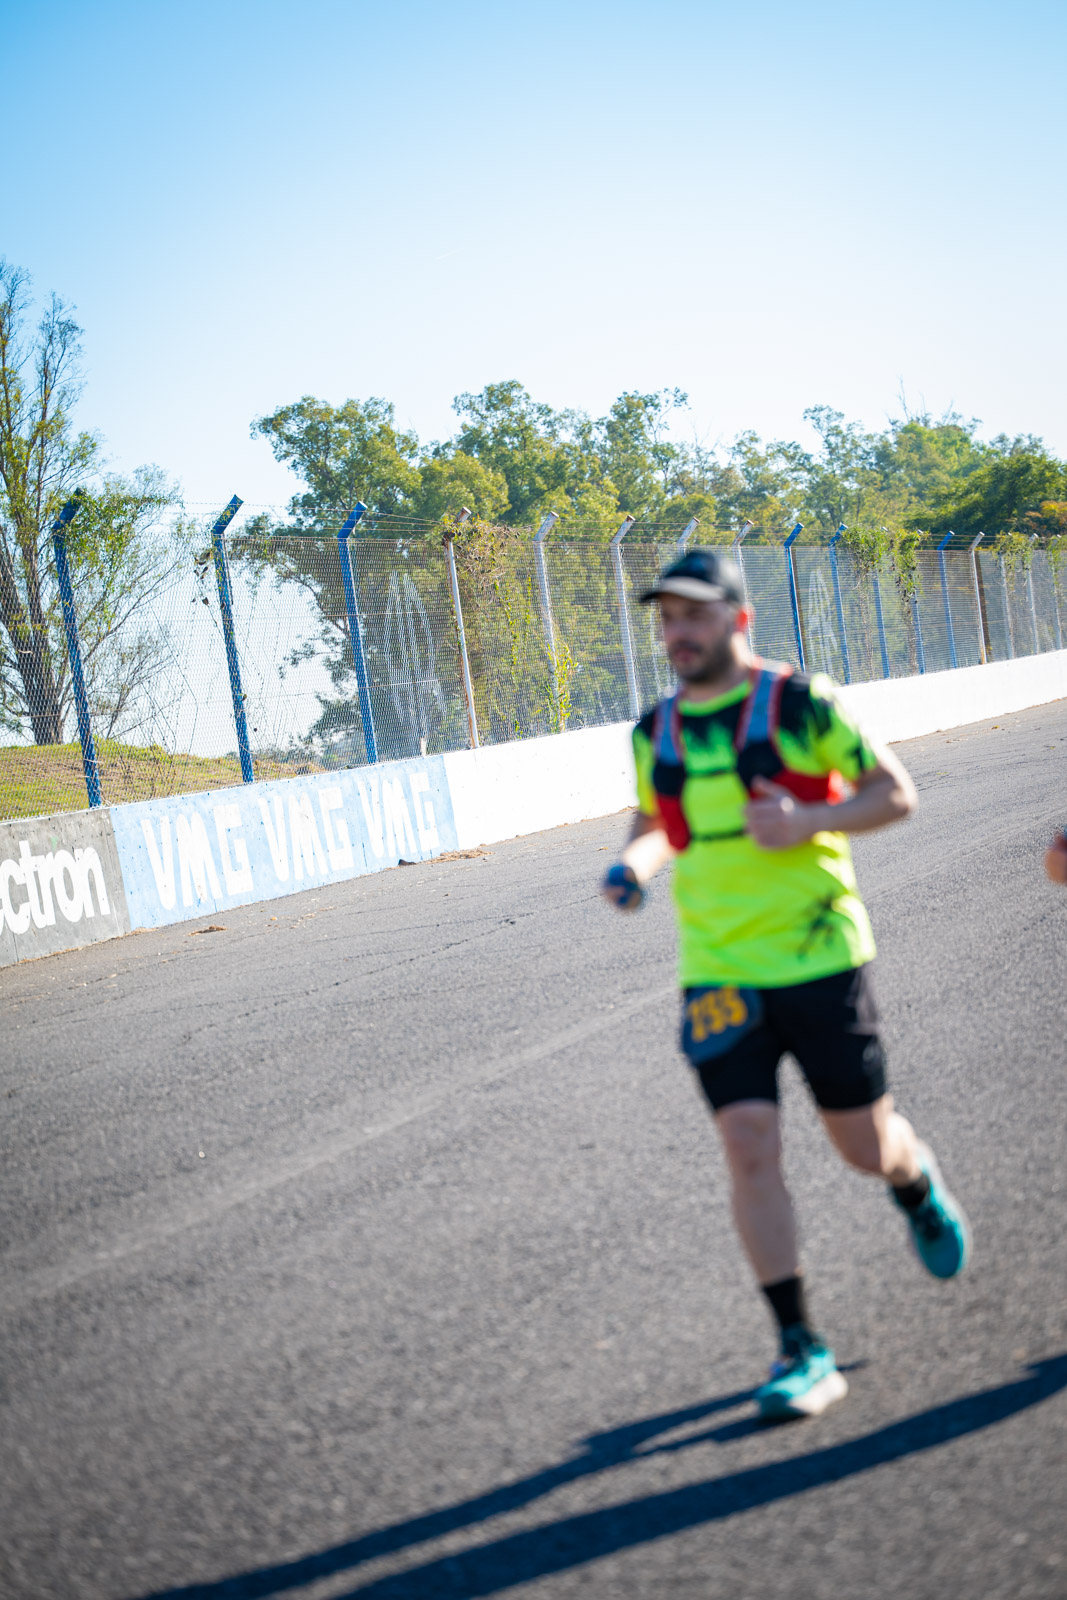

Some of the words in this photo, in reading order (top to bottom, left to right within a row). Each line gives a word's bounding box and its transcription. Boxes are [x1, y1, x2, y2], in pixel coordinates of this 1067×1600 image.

[0, 840, 111, 935] ctron
[140, 803, 254, 910] VMG
[257, 787, 354, 882] VMG
[356, 772, 440, 858] VMG
